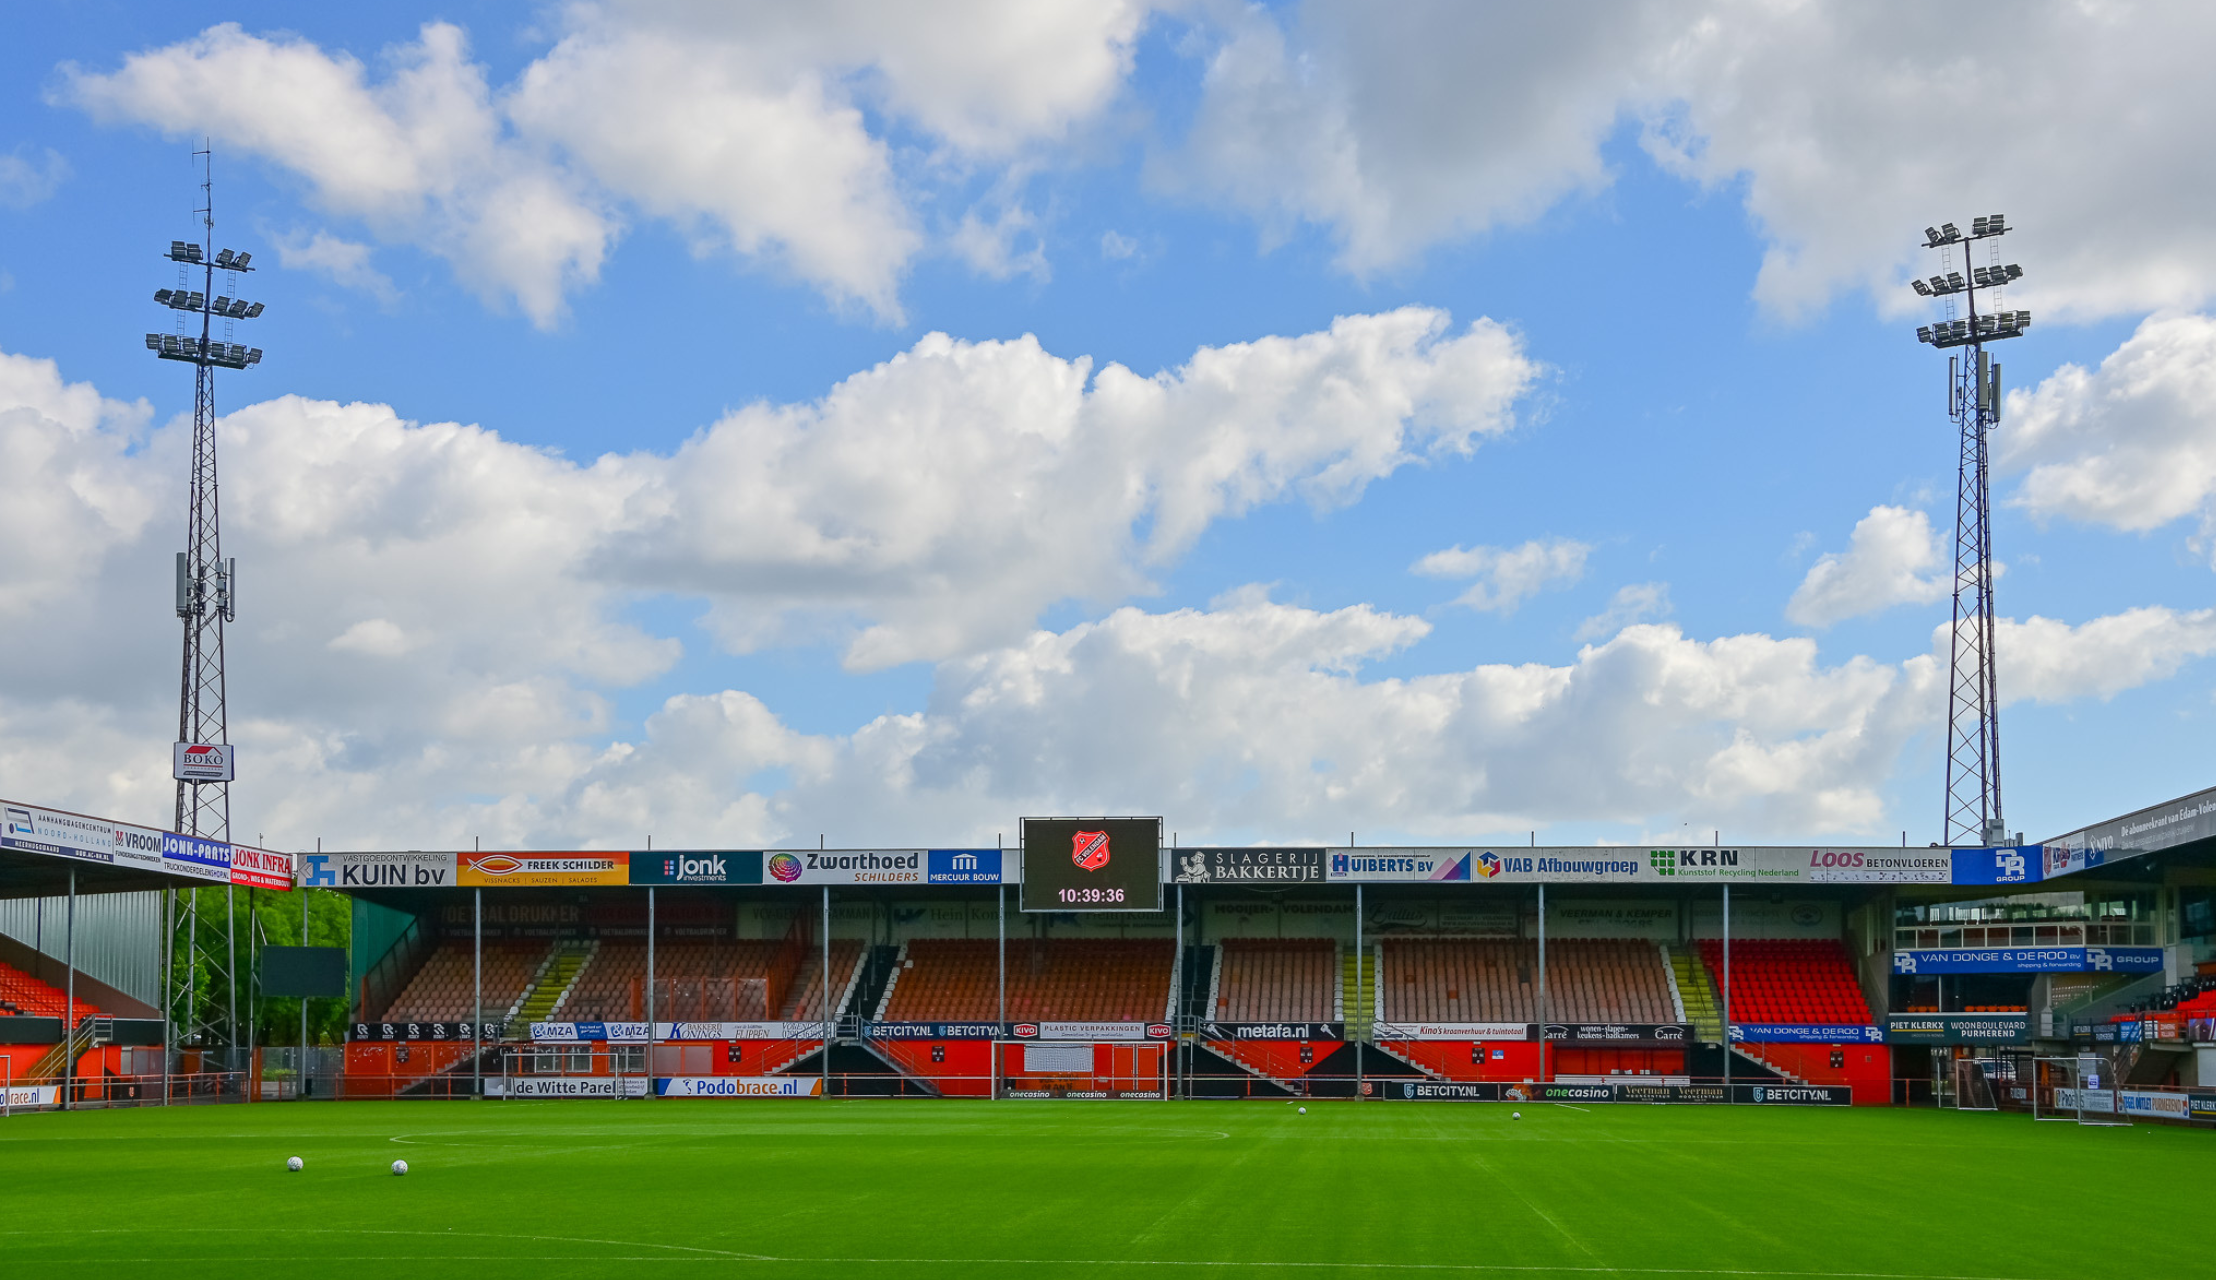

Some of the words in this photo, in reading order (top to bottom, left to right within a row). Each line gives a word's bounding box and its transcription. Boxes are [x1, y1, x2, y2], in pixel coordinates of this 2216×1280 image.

[184, 754, 224, 764] BOKO
[38, 814, 112, 834] AANHANGWAGENCENTRUM
[2168, 814, 2178, 824] van
[125, 832, 161, 853] VROOM
[164, 837, 230, 862] JONK-PARTS
[233, 849, 260, 869] JONK
[262, 854, 291, 874] INFRA
[806, 853, 918, 870] Zwarthoed
[1216, 853, 1318, 864] SLAGERIJ
[1333, 855, 1414, 872] HUIBERTS
[1418, 862, 1433, 871] BV
[1680, 850, 1738, 866] KRN
[1810, 850, 1864, 867] LOOS
[1866, 858, 1948, 867] BETONVLOEREN
[164, 862, 229, 880] TRUCKONDERDELENSHOP.NL
[528, 861, 560, 870] FREEK
[563, 861, 614, 870] SCHILDER
[677, 854, 726, 880] jonk
[1504, 858, 1533, 873] VAB
[1537, 857, 1638, 875] Afbouwgroep
[342, 864, 406, 885] KUIN
[415, 864, 445, 885] bv
[855, 872, 918, 882] SCHILDERS
[1215, 866, 1319, 881] BAKKERTJE
[1719, 868, 1756, 877] Recycling
[1058, 888, 1124, 902] 10:39:36
[1283, 904, 1354, 914] VOLENDAM
[1560, 909, 1613, 918] VEERMAN
[1616, 909, 1622, 918] &
[1626, 909, 1672, 918] KEMPER
[1921, 953, 1948, 962] VAN
[1953, 953, 1999, 962] DONGE
[2017, 952, 2035, 961] DE
[2038, 952, 2067, 960] ROO
[547, 1026, 572, 1036] MZA
[872, 1026, 933, 1036] BETCITY.NL
[947, 1026, 1008, 1036] BETCITY.NL
[1237, 1024, 1309, 1038] metafa.nl
[1654, 1030, 1683, 1040] Carré
[516, 1081, 534, 1093] de
[537, 1081, 578, 1093] Witte
[581, 1081, 616, 1093] Parel
[697, 1079, 797, 1094] Podobrace.nl
[1417, 1086, 1480, 1097] BETCITY.NL
[1626, 1086, 1670, 1094] Veerman
[1679, 1086, 1723, 1095] Veerman
[1546, 1087, 1609, 1098] onecasino
[1767, 1089, 1831, 1100] BETCITY.NL
[2190, 1100, 2200, 1110] PIET
